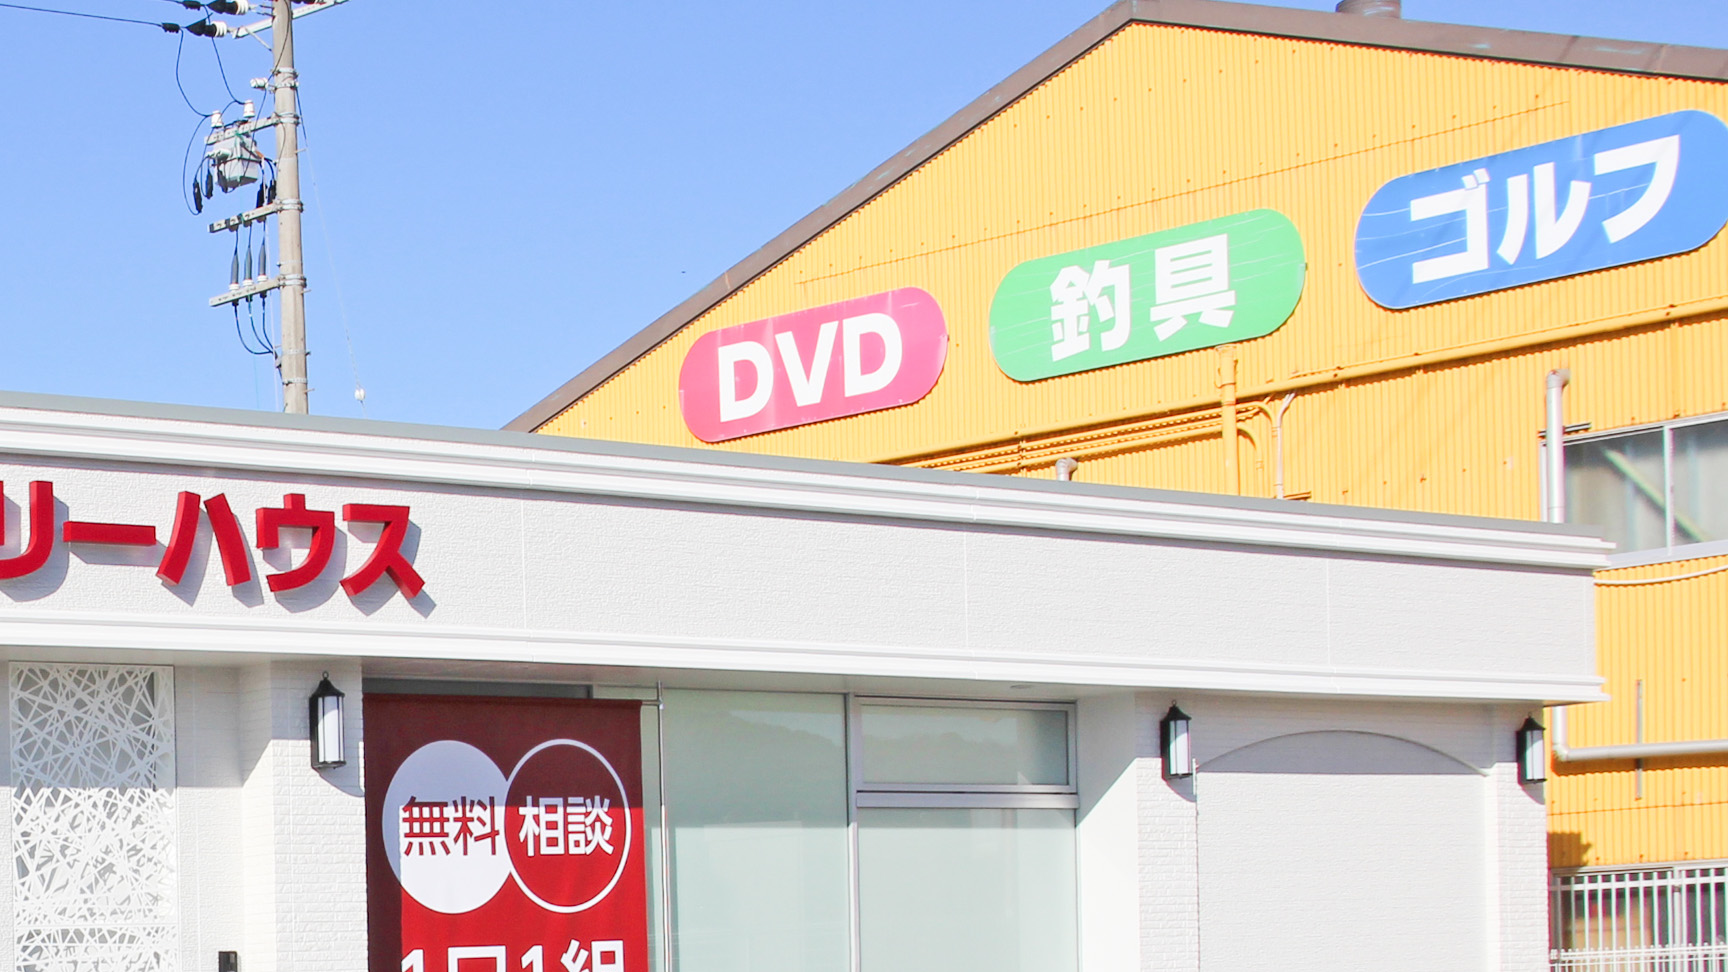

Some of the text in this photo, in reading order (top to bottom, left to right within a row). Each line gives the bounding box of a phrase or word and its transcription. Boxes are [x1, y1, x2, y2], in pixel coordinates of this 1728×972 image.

[1410, 134, 1682, 285] ゴルフ
[1048, 232, 1238, 364] 釣具
[717, 312, 903, 423] DVD
[402, 795, 615, 857] 無料 相談
